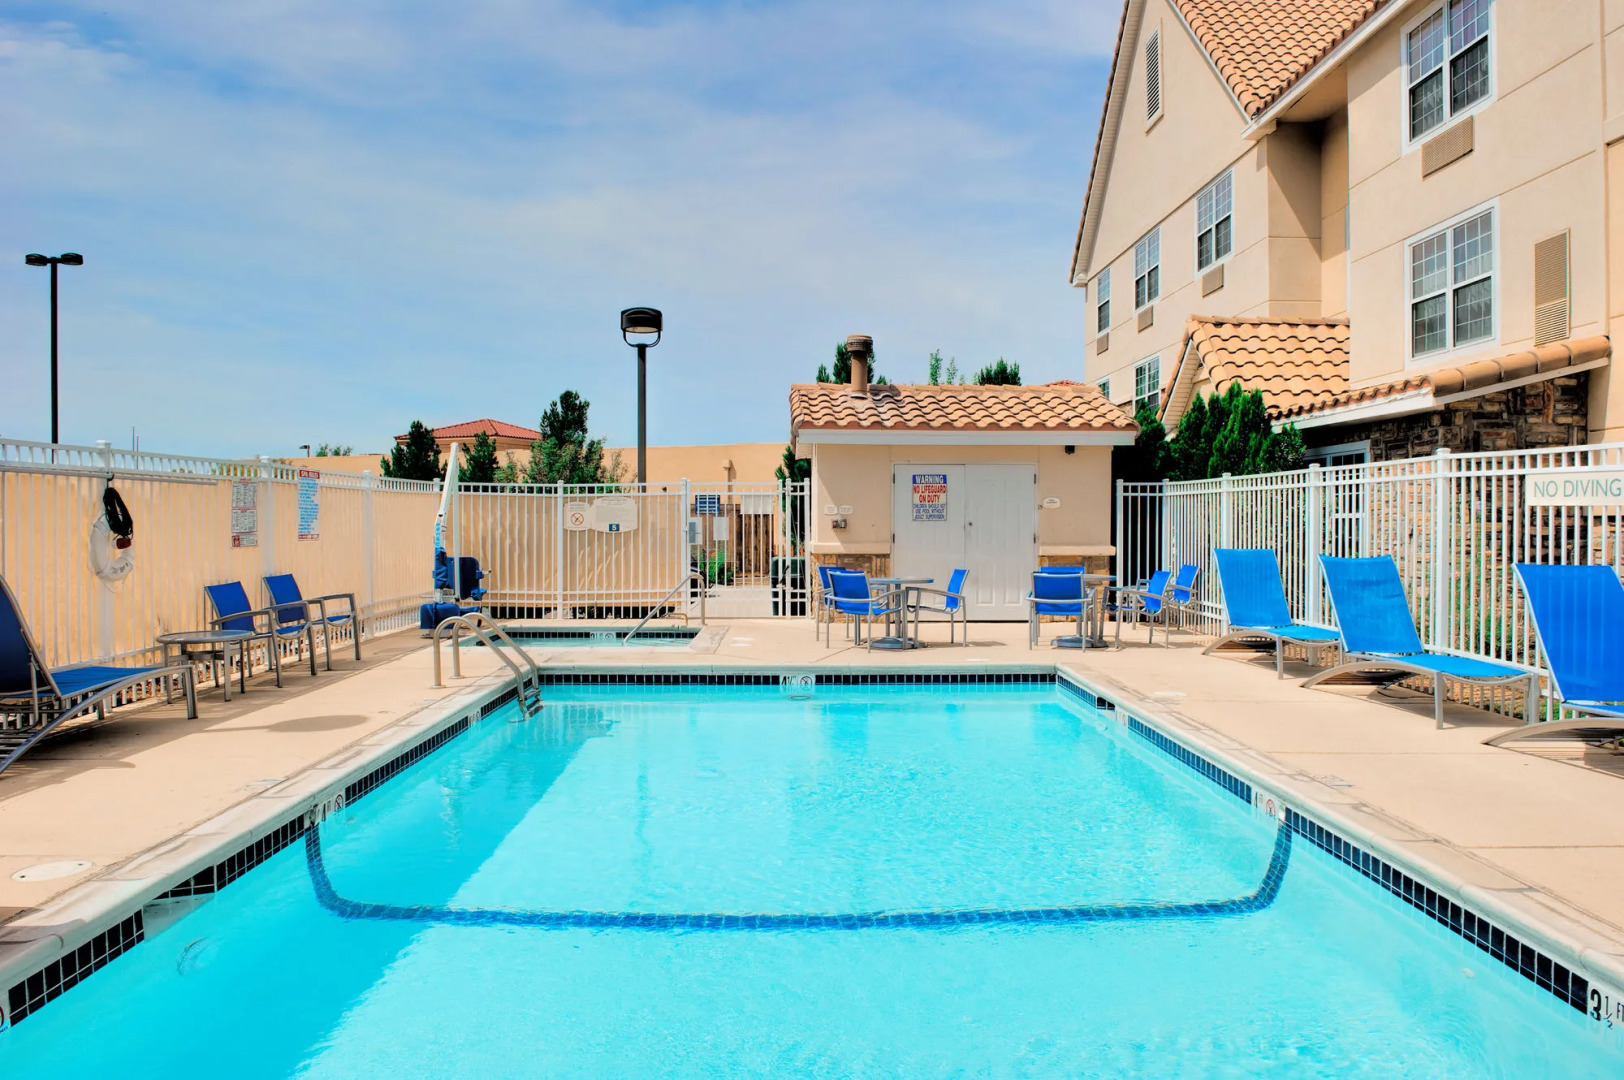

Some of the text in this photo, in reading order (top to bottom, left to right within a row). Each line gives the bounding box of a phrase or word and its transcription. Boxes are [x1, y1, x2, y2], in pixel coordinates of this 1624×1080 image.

[915, 475, 944, 484] WARNING
[912, 486, 946, 494] NO LIFEGUARD
[1533, 478, 1622, 497] NO DIVING
[919, 494, 940, 502] ON DUTY
